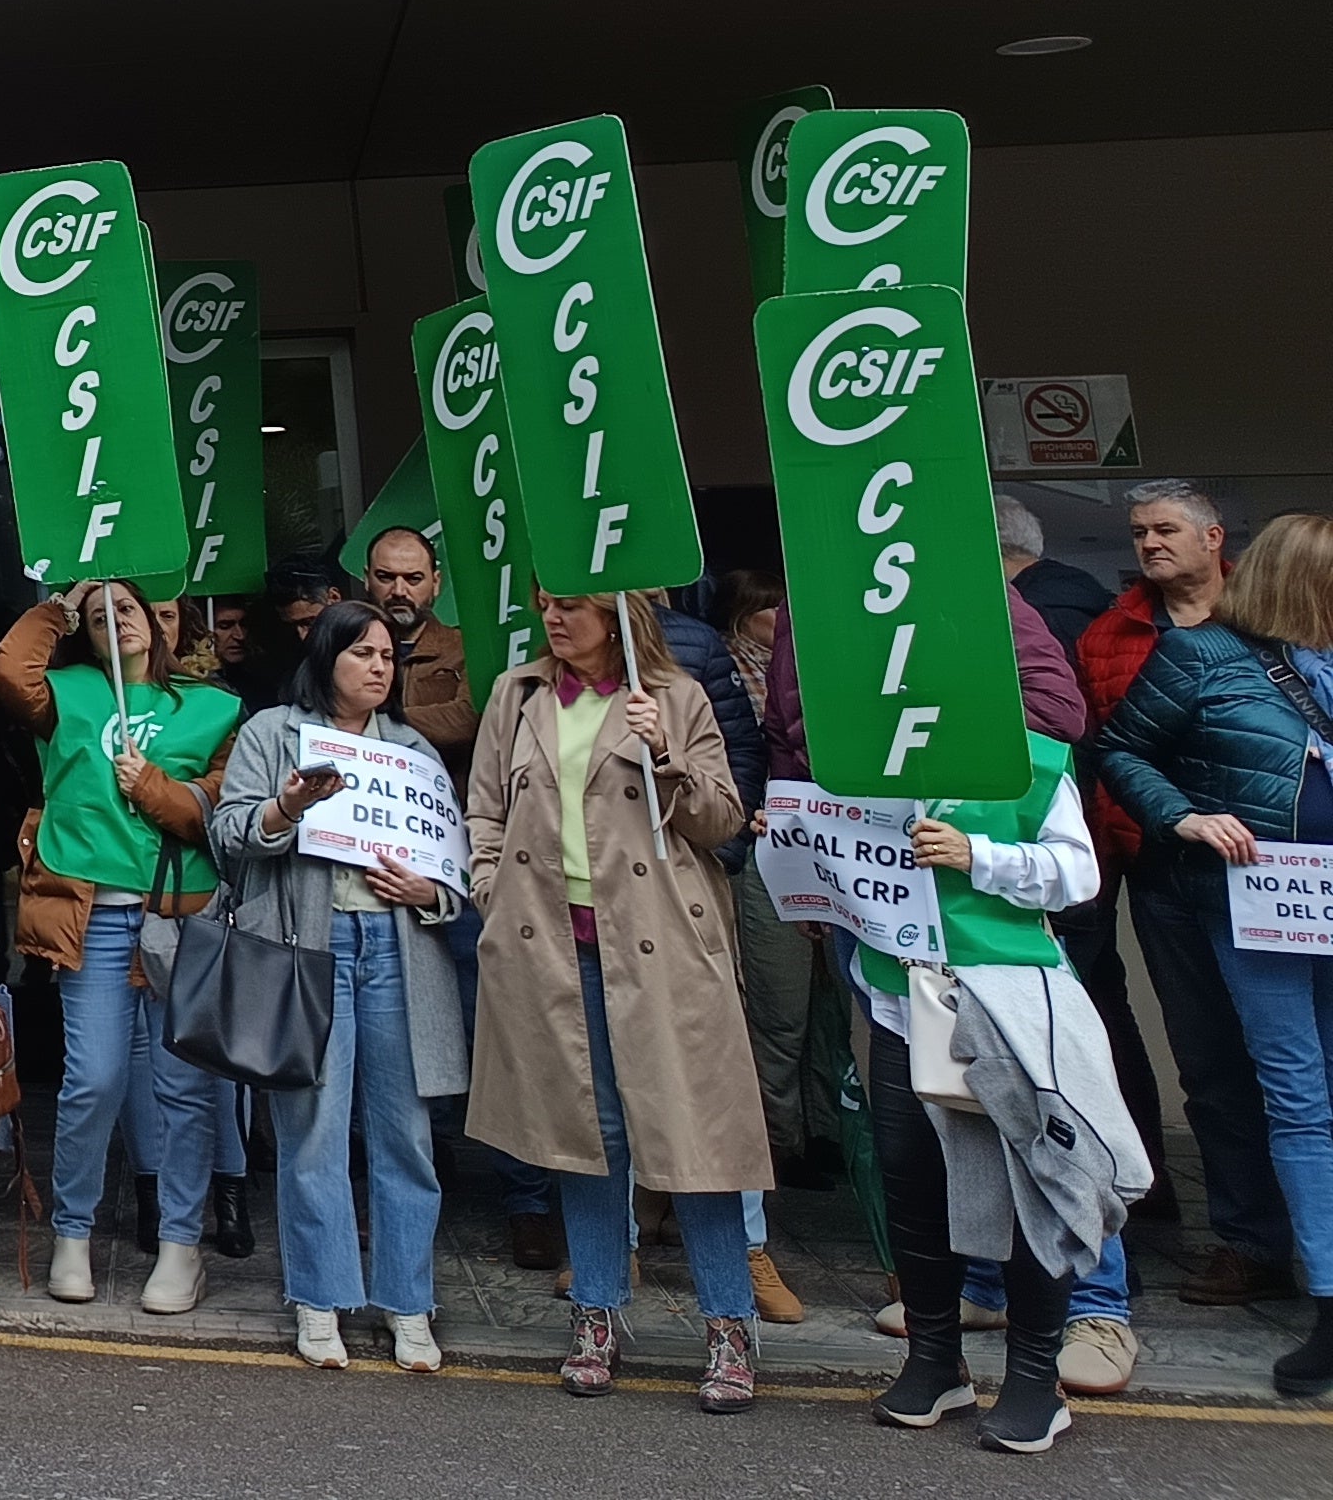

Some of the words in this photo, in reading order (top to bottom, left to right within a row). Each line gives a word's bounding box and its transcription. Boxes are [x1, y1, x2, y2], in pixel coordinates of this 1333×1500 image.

[518, 171, 611, 232] CSIF
[833, 161, 947, 208] CSIF
[22, 210, 117, 258] CSIF
[175, 300, 246, 332] CSIF
[816, 344, 945, 399] CSIF
[54, 305, 122, 562] CSIF
[553, 281, 629, 575] CSIF
[1032, 443, 1094, 451] PROHIBIDO
[1045, 452, 1084, 460] FUMAR
[190, 375, 224, 582] CSIF
[857, 461, 941, 777] CSIF
[363, 750, 393, 766] UGT
[344, 772, 360, 790] O
[367, 777, 398, 799] AL
[405, 786, 457, 827] ROBO
[807, 800, 844, 817] UGT
[353, 804, 398, 830] DEL
[405, 815, 446, 842] CRP
[360, 840, 393, 856] UGT
[770, 828, 810, 848] NO
[813, 833, 845, 859] AL
[854, 840, 916, 871] ROB
[1280, 856, 1307, 866] UGT
[853, 878, 910, 905] CRP
[1245, 875, 1280, 892] NO
[1286, 878, 1315, 895] AL
[1276, 902, 1318, 920] DEL
[1286, 931, 1315, 943] UGT
